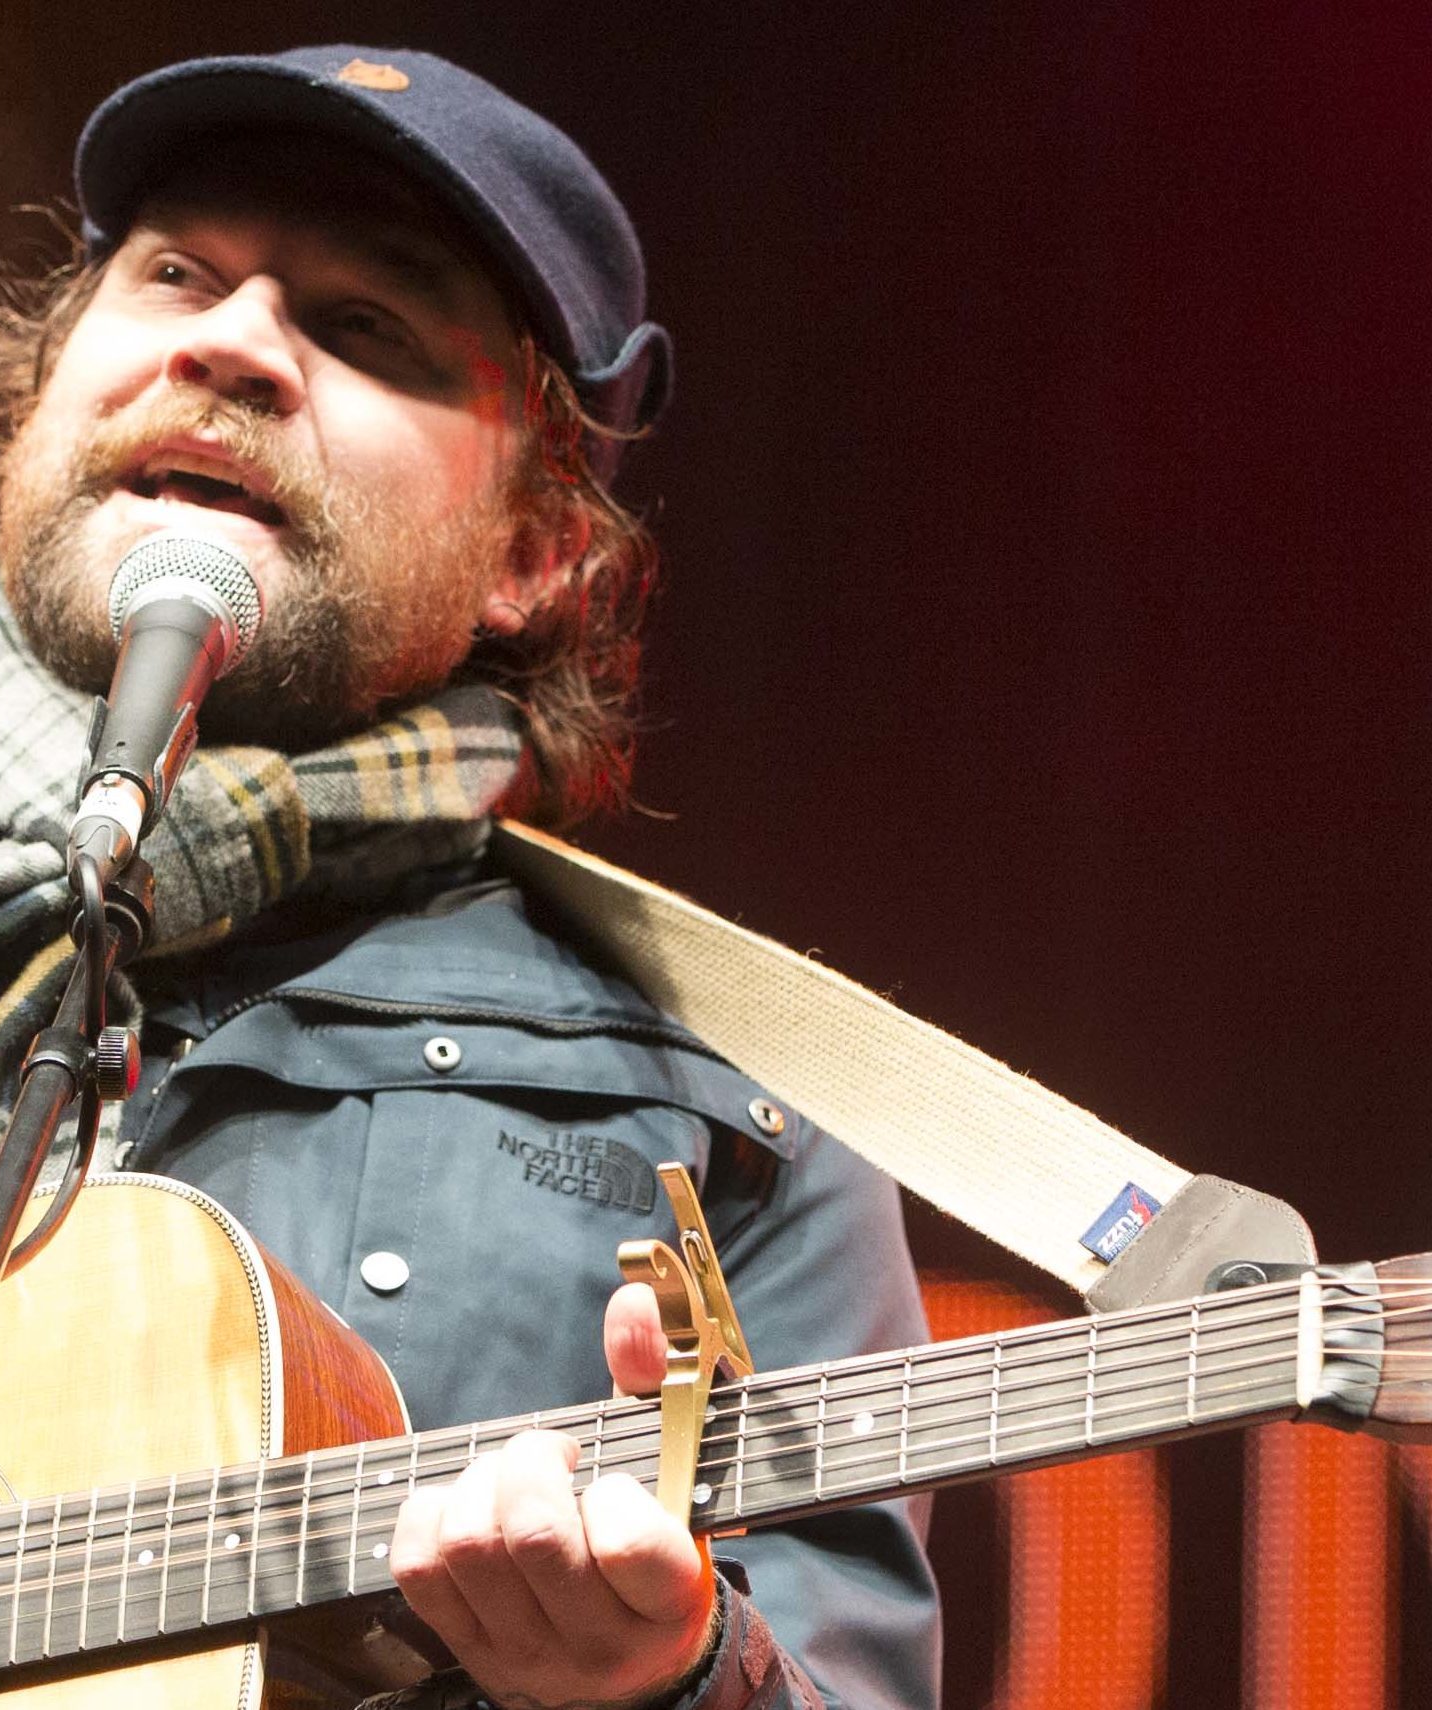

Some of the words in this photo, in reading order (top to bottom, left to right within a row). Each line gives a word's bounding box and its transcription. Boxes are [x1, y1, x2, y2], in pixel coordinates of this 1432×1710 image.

[497, 1129, 603, 1179] NORTH
[546, 1129, 605, 1158] THE
[523, 1163, 600, 1202] FACE
